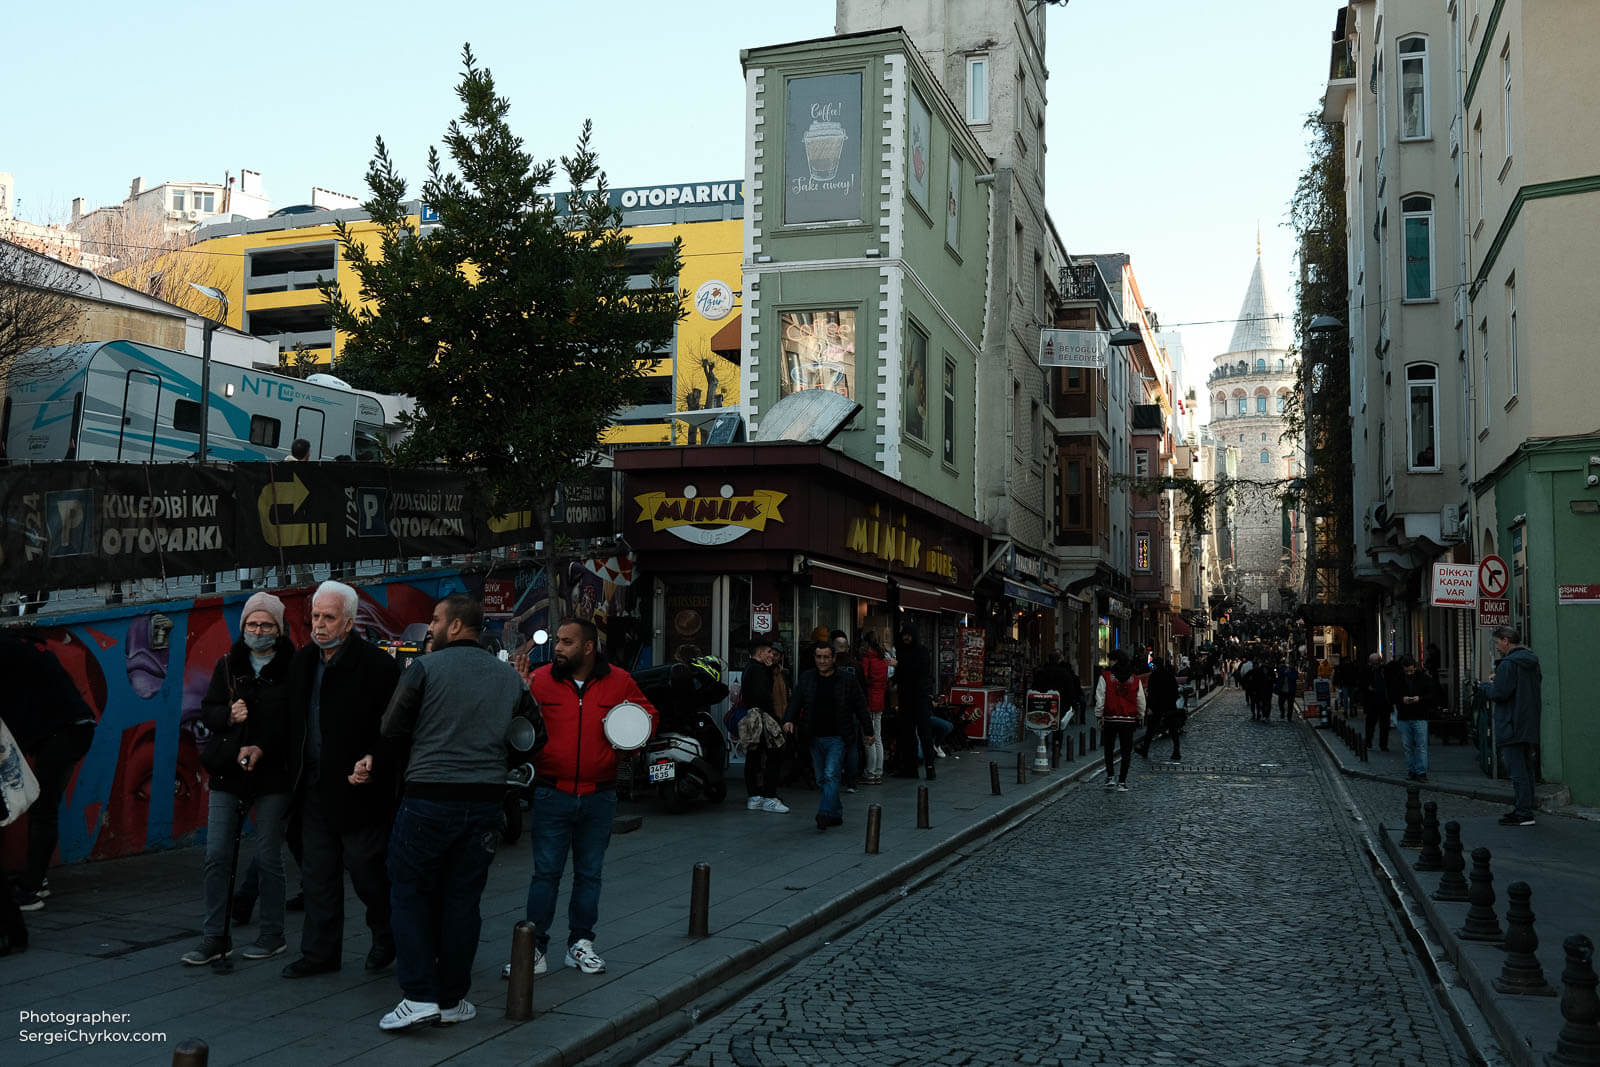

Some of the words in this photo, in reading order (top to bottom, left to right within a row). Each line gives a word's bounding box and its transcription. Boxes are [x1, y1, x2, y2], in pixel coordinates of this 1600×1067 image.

[811, 102, 842, 122] Coffee!
[791, 176, 818, 195] Take
[822, 173, 855, 196] away!
[621, 183, 736, 208] OTOPARKI
[103, 489, 188, 519] KULEDİBİ
[192, 494, 219, 517] KAT
[445, 494, 464, 512] KAT
[102, 525, 223, 556] OTOPARKI
[847, 502, 921, 569] MİNİK
[1439, 567, 1474, 578] DİKKAT
[1439, 578, 1473, 587] KAPAN
[1446, 588, 1465, 597] VAR
[1484, 601, 1506, 613] DİKKAT
[1480, 614, 1498, 625] TUZAK
